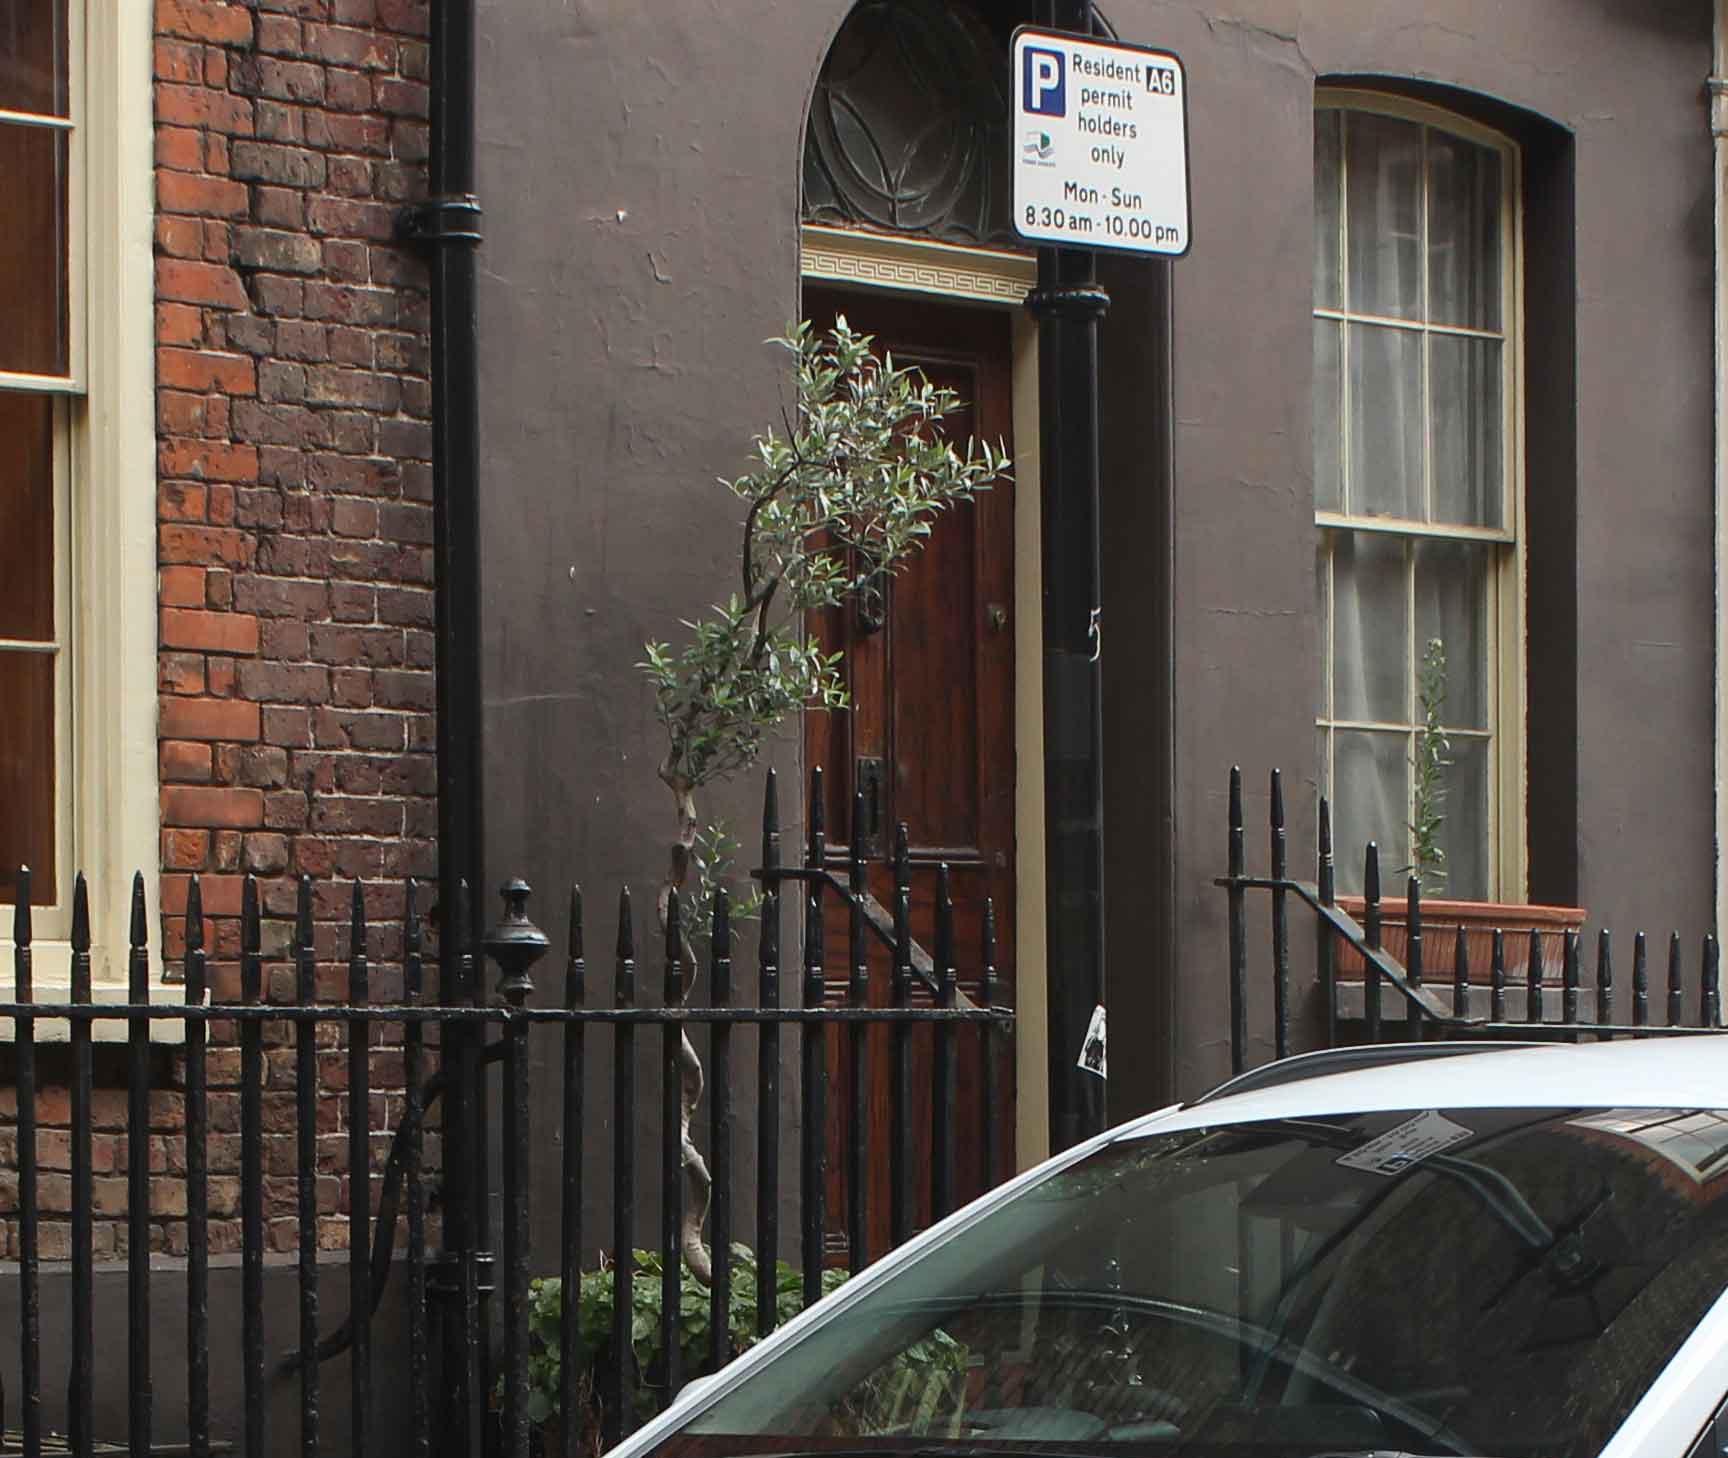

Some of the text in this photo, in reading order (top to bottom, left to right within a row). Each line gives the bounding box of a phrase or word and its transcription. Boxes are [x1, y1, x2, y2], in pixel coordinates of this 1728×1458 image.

[1031, 52, 1060, 110] P
[1072, 53, 1141, 83] Resident
[1147, 68, 1174, 95] A6
[1081, 86, 1133, 111] permit
[1078, 112, 1137, 139] holders
[1091, 145, 1125, 169] only
[1063, 181, 1098, 203] Mon
[1111, 187, 1142, 209] Sun
[1025, 206, 1065, 228] 8.30
[1068, 215, 1092, 233] am
[1105, 215, 1152, 239] 10.00
[1155, 223, 1179, 244] pm
